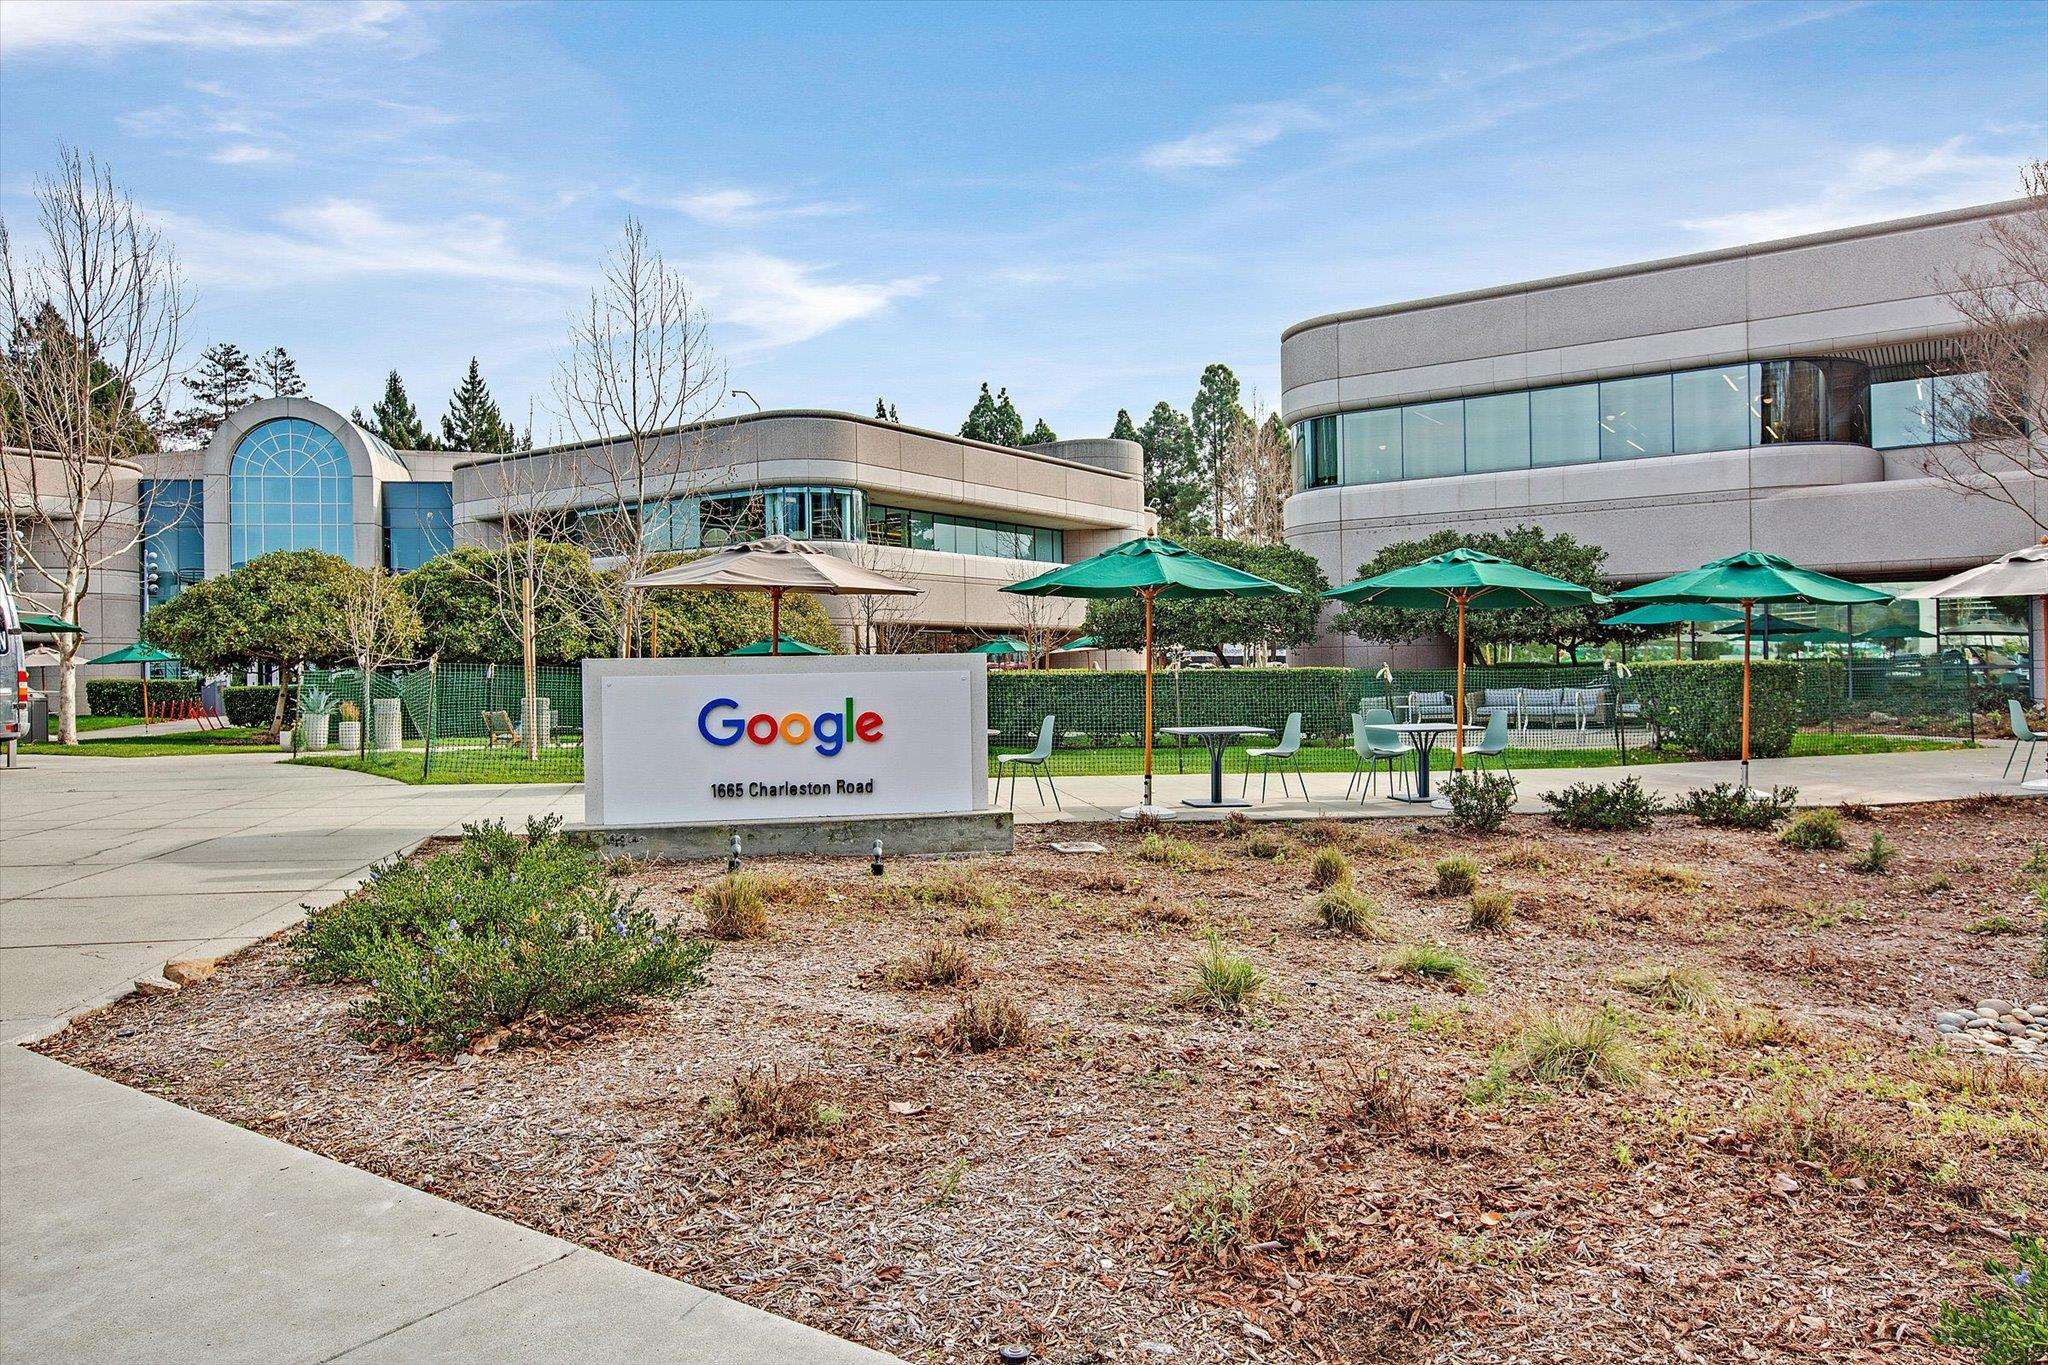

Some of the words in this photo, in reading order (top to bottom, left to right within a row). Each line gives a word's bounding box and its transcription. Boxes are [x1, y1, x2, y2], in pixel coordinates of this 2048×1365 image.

[698, 697, 884, 757] Google
[711, 783, 744, 798] 1665
[749, 781, 831, 797] Charleston
[836, 779, 874, 794] Road
